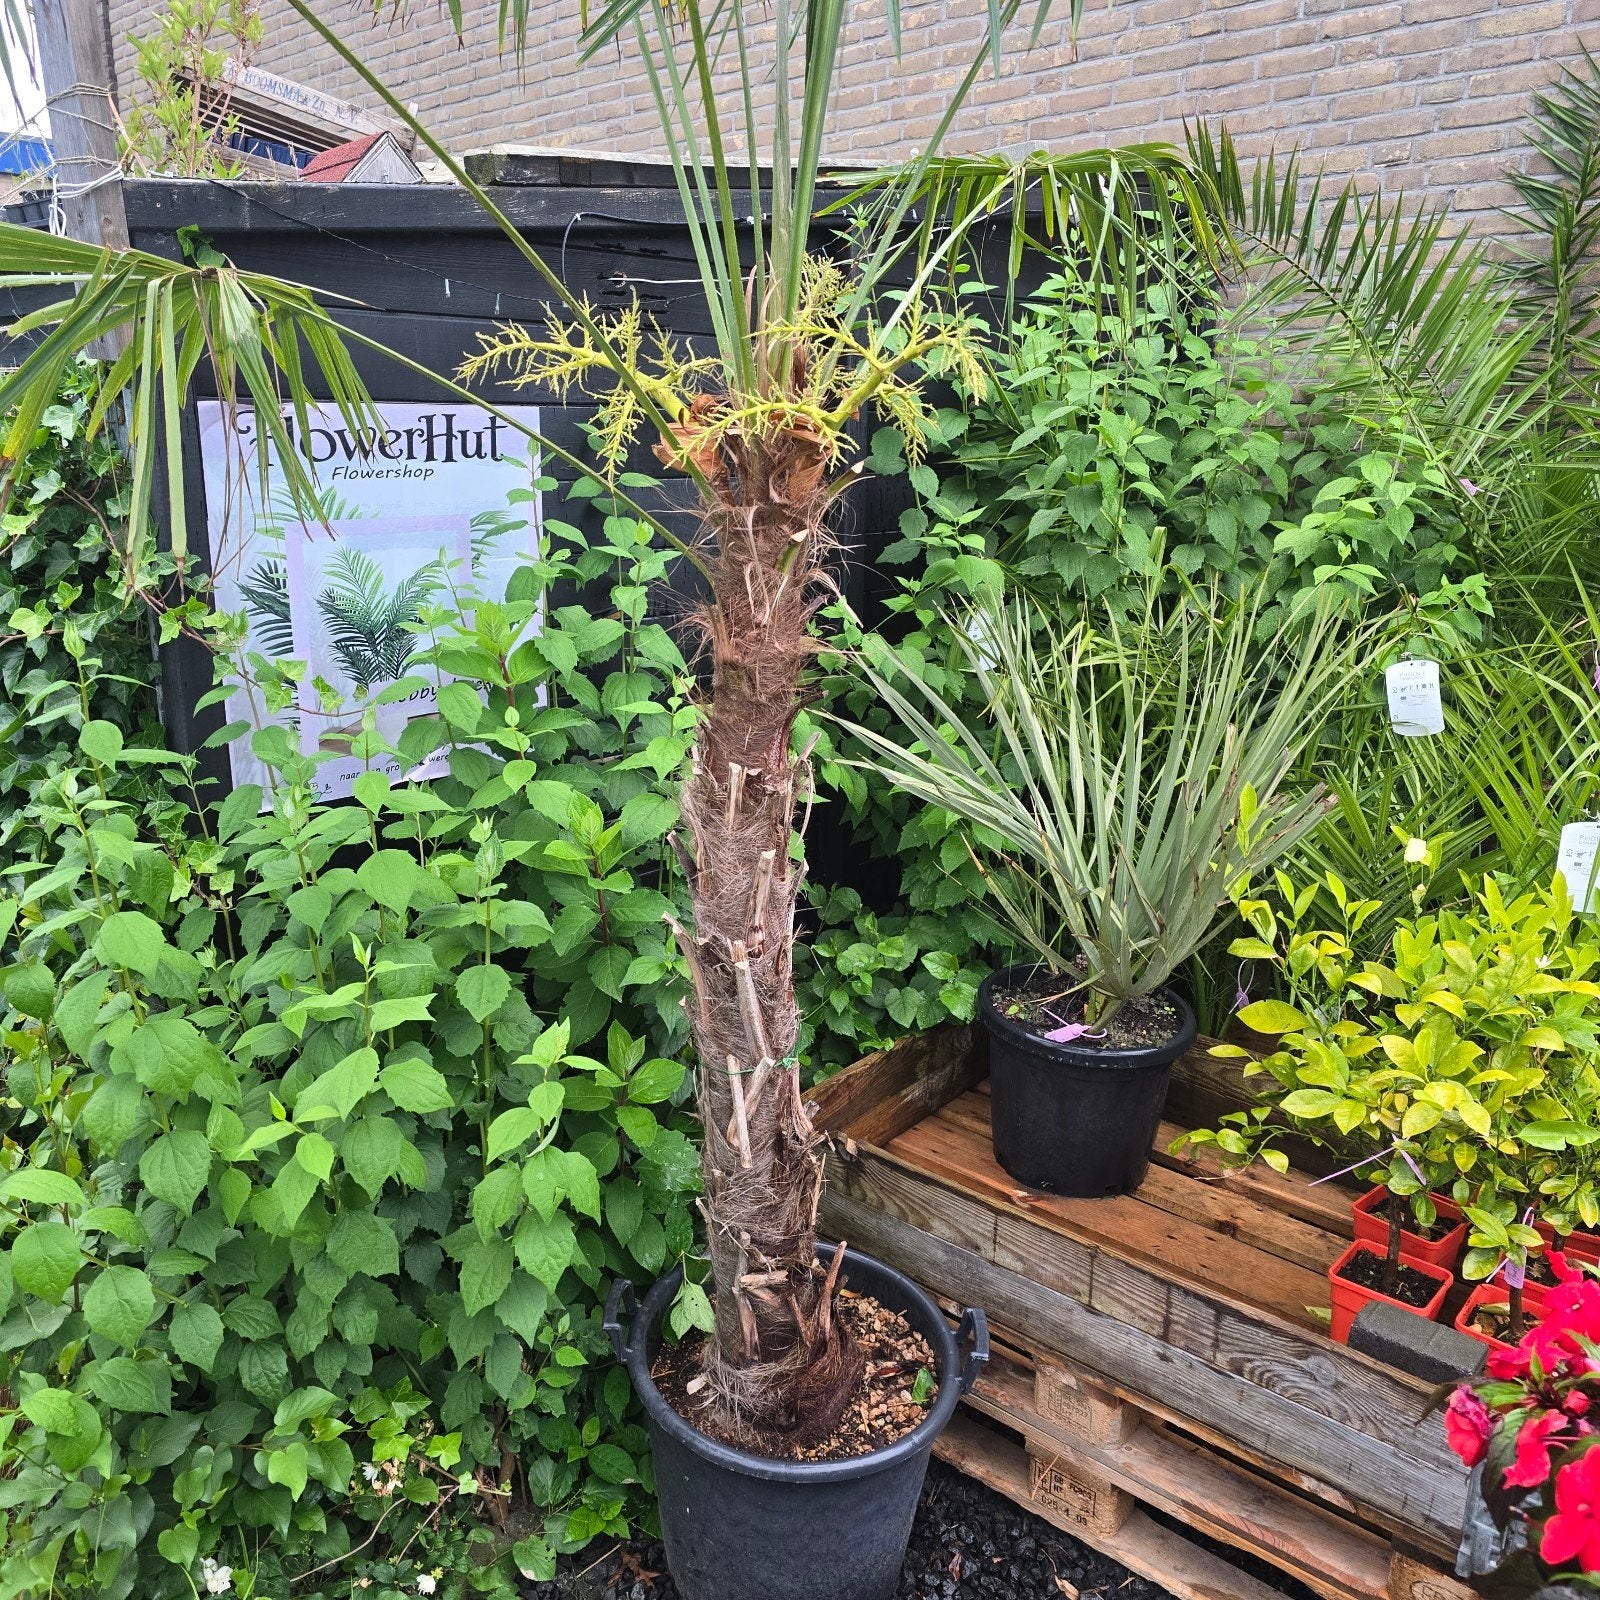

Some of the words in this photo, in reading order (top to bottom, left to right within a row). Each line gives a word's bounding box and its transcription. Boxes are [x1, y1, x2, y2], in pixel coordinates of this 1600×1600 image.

[244, 69, 301, 104] BOOMSMA
[332, 464, 435, 481] Flowershop
[340, 772, 361, 781] naar
